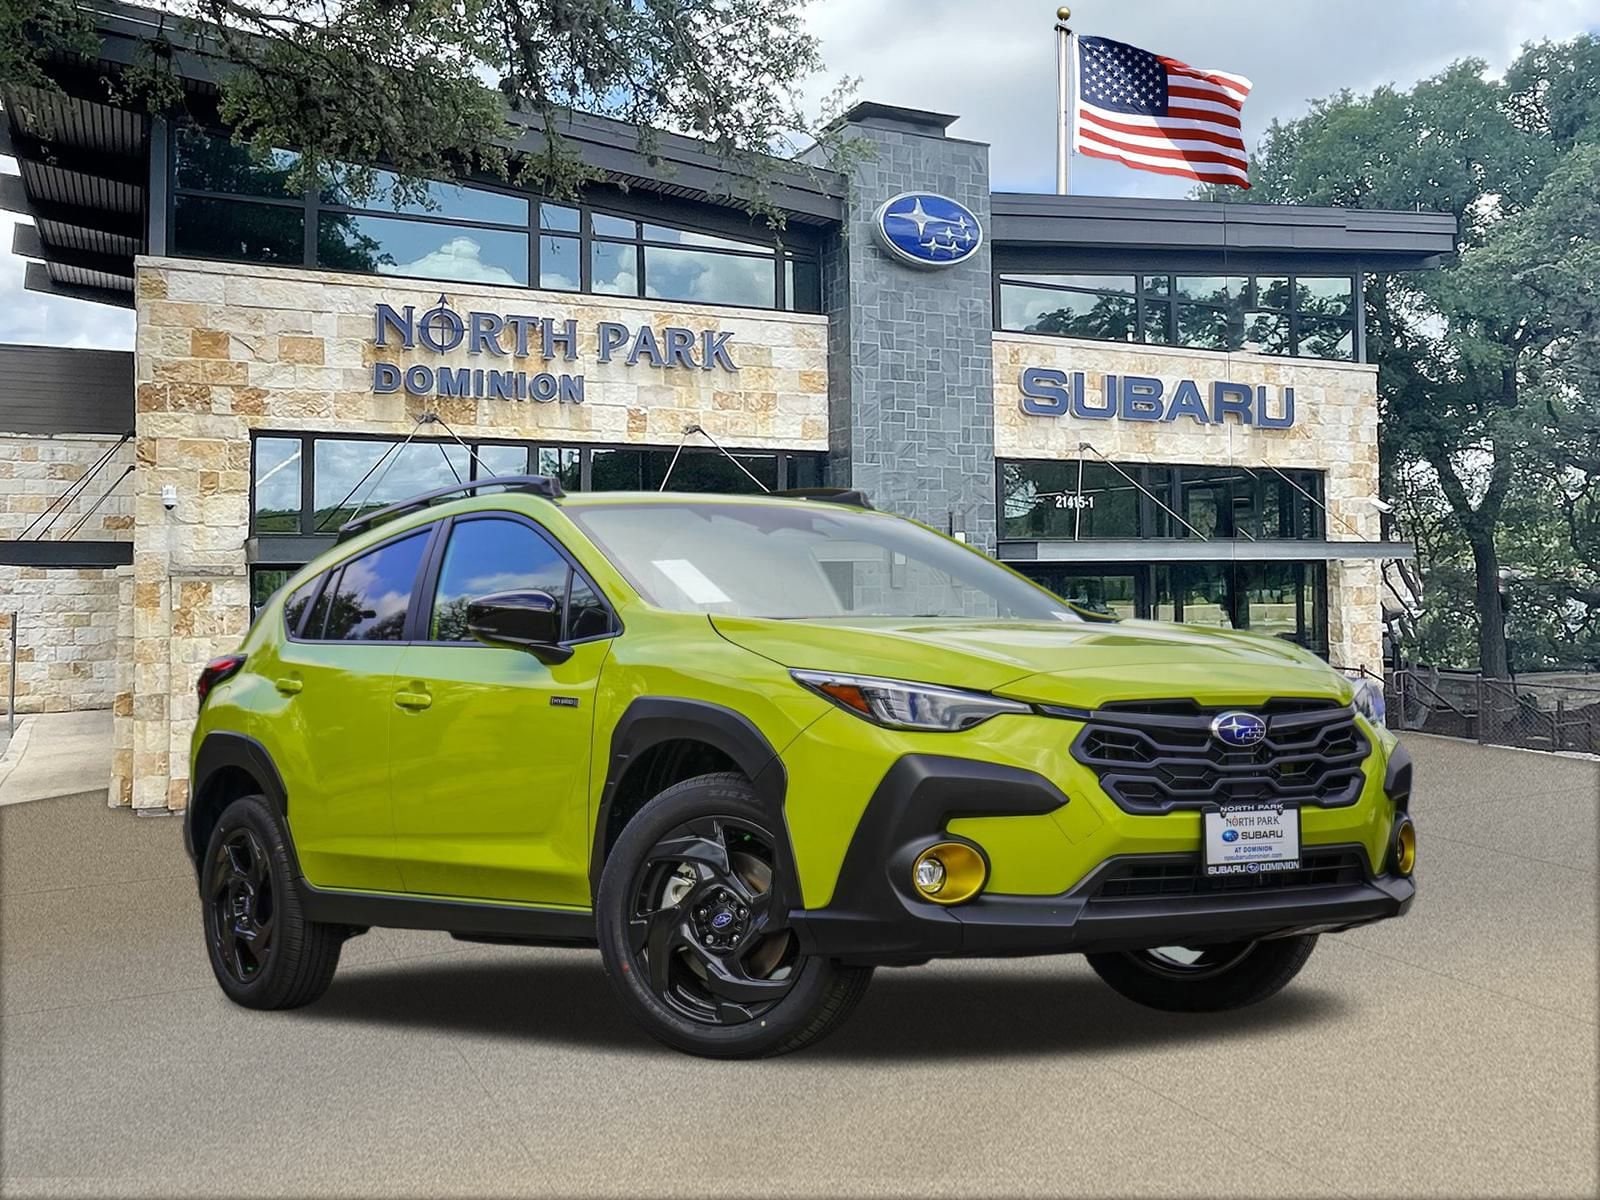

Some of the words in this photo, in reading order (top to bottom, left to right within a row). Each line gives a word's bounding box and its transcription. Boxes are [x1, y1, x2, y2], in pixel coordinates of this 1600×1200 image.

[375, 293, 579, 361] NORTH
[597, 321, 741, 373] PARK
[373, 362, 585, 404] DOMINION
[1020, 366, 1295, 430] SUBARU
[1225, 815, 1255, 828] NORTH
[1257, 816, 1281, 826] PARK
[1241, 830, 1284, 840] SUBARU
[1243, 845, 1273, 853] DOMINION
[1207, 864, 1246, 875] SUBARU
[1260, 861, 1300, 872] DOMINION
